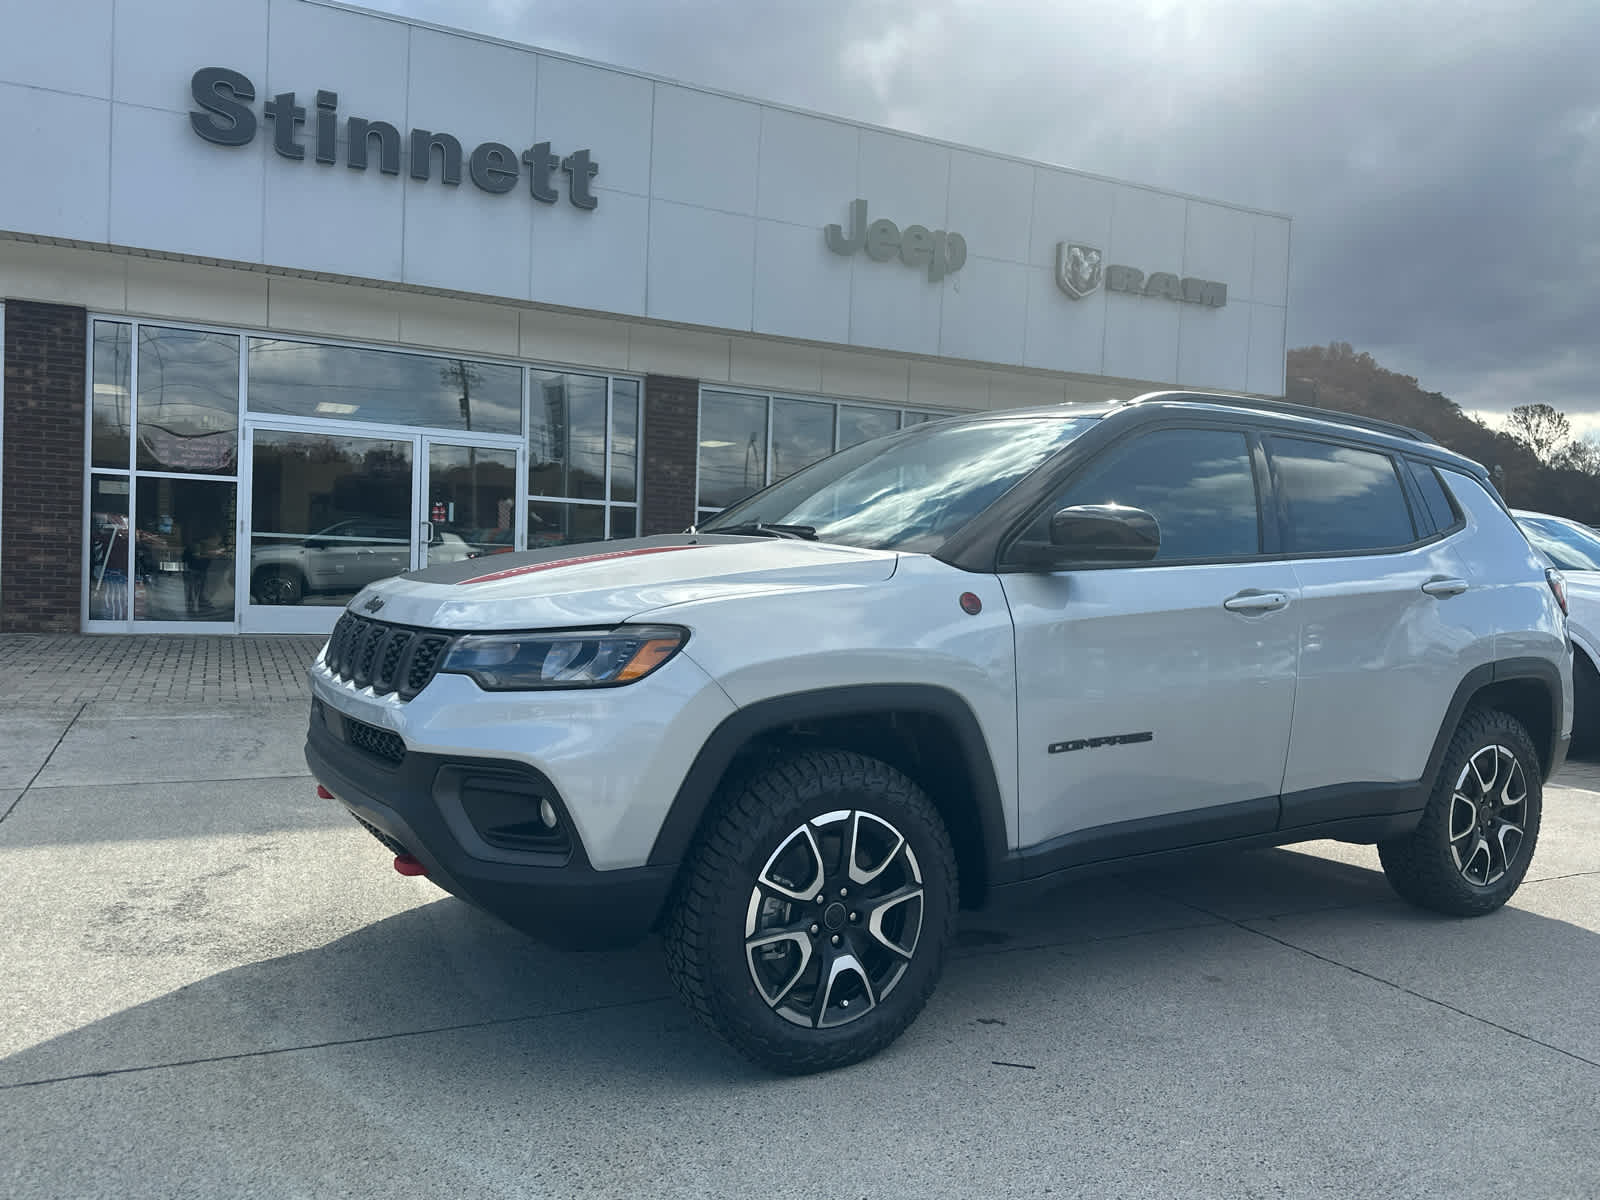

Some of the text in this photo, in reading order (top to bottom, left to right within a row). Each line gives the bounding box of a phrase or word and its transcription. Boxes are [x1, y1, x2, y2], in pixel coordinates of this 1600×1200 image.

[190, 67, 599, 210] Stinnett
[824, 198, 967, 283] Jeep
[1105, 264, 1228, 308] RAM
